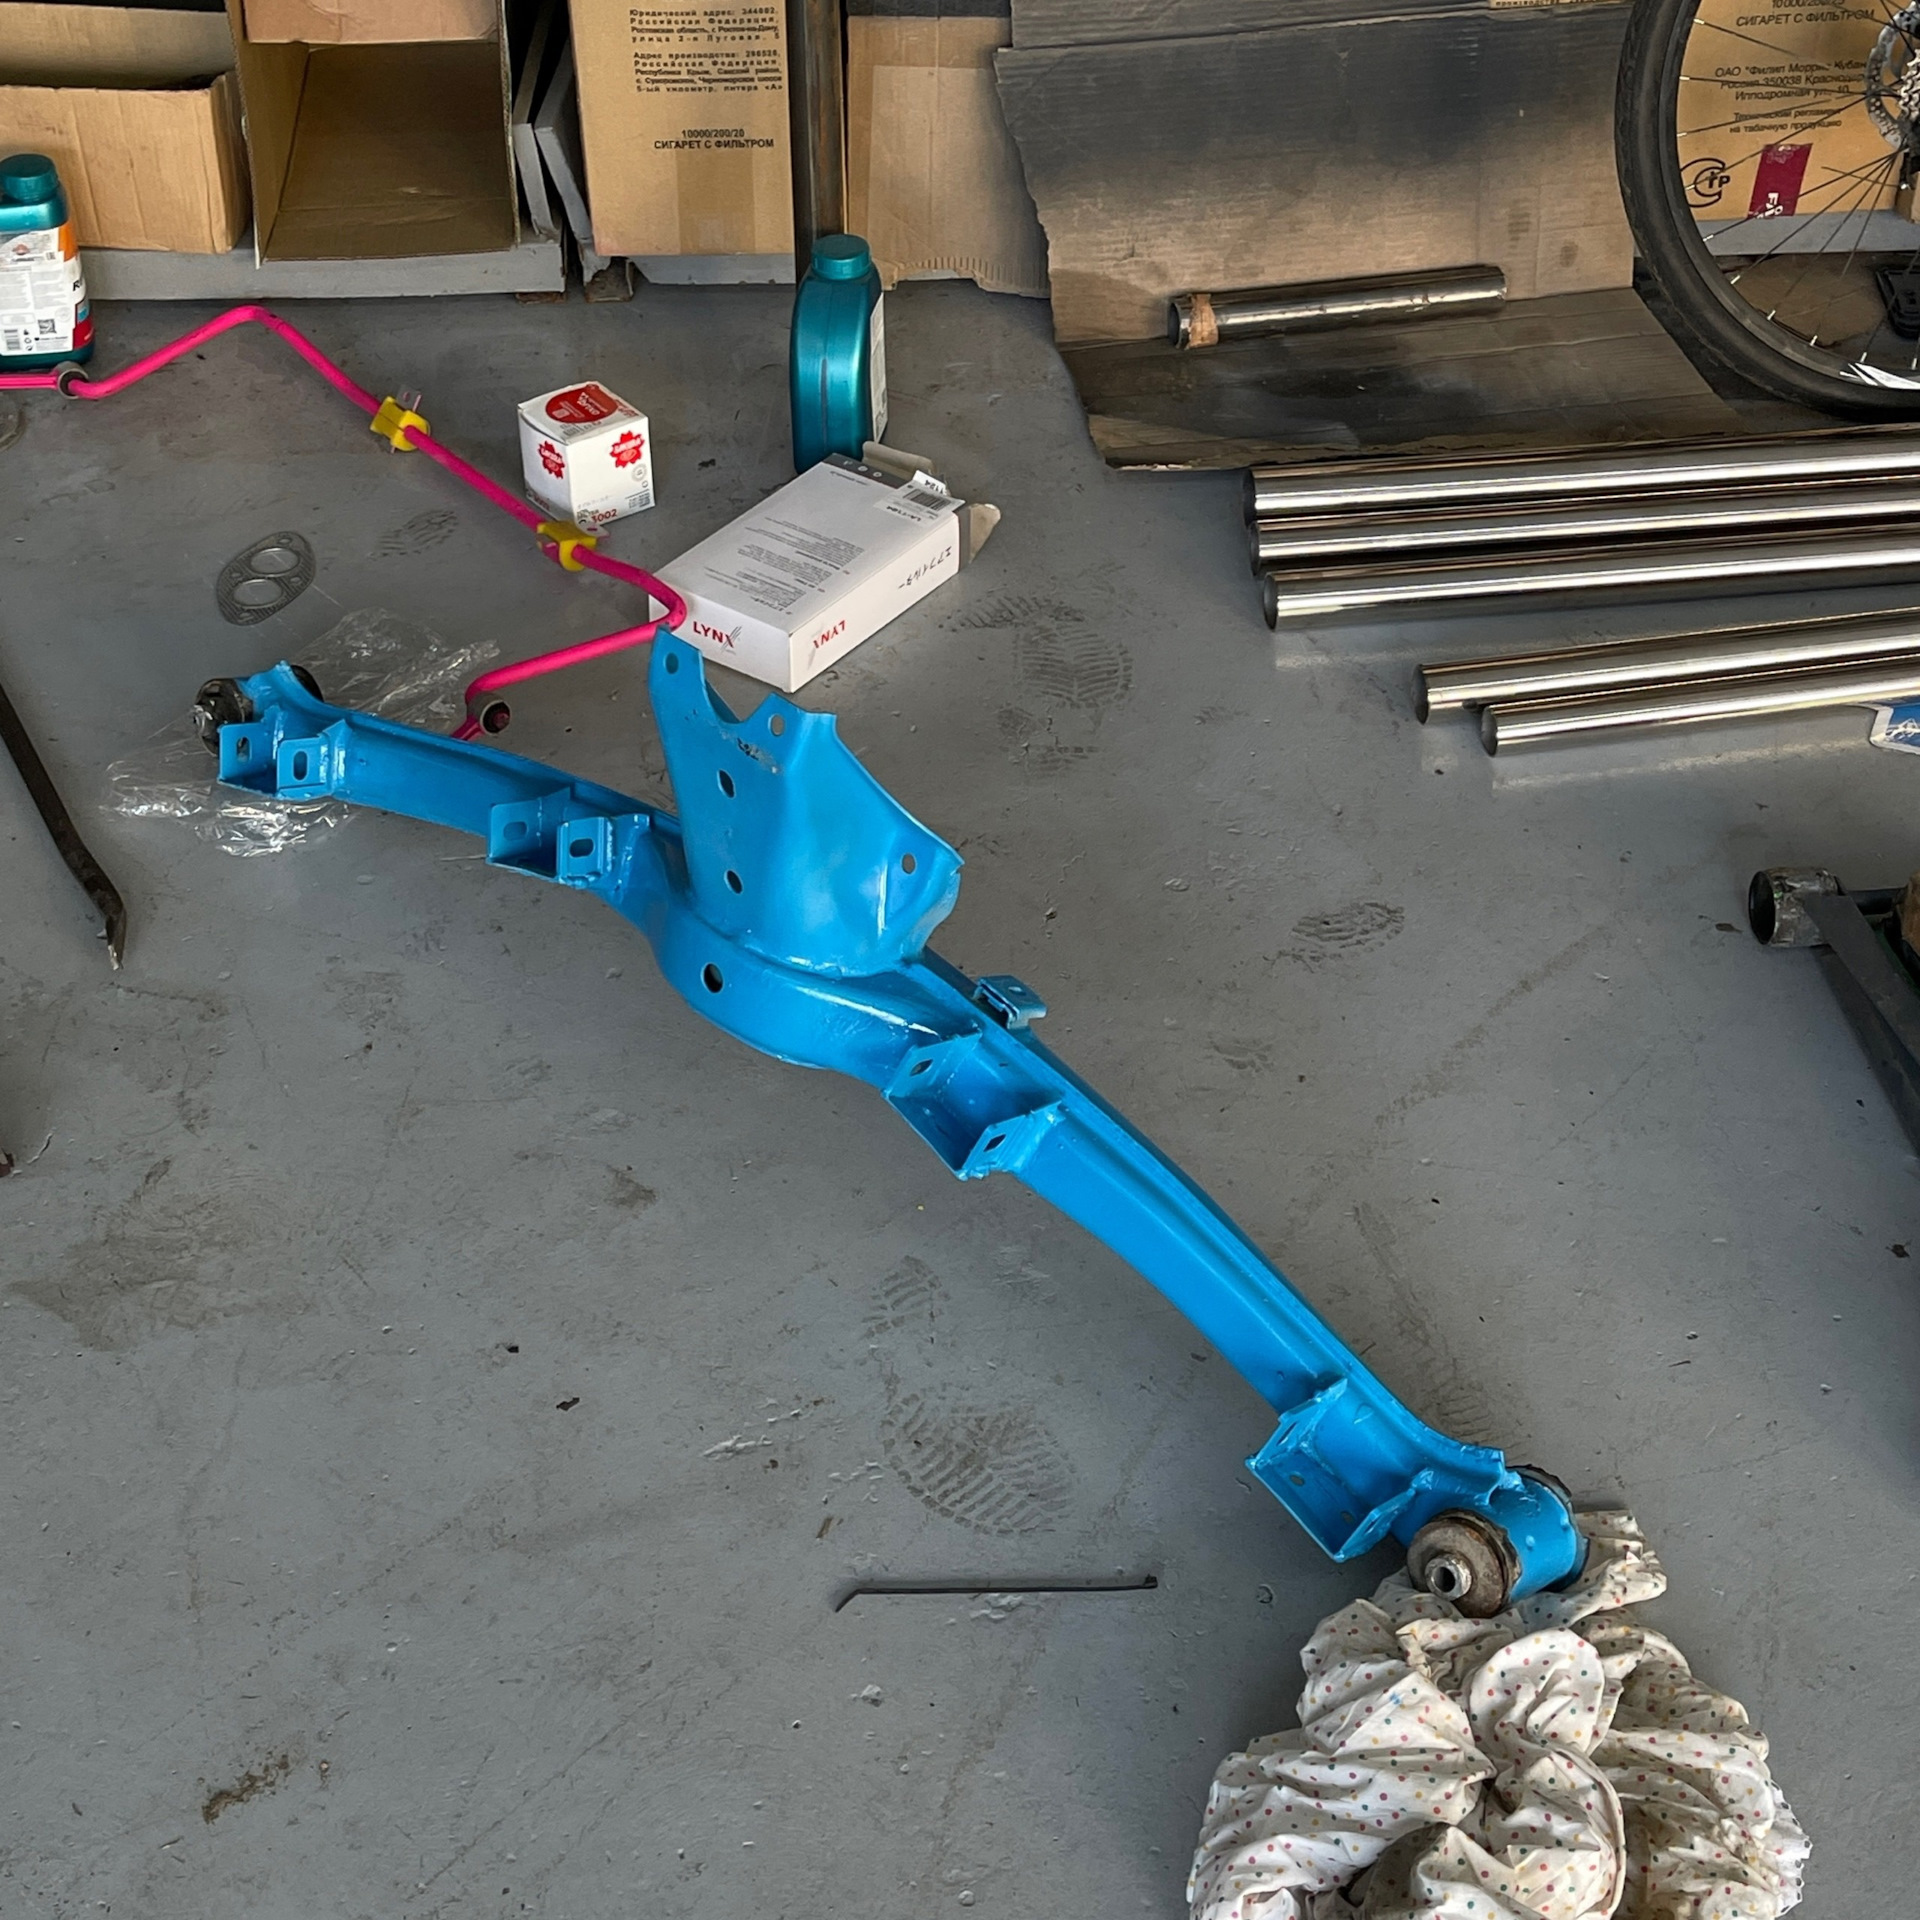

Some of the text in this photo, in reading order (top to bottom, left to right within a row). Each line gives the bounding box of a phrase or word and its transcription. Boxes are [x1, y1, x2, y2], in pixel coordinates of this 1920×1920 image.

[1736, 9, 1875, 26] СИГАРЕТ С ФИЛЬТРОМ
[634, 52, 662, 60] Адрес
[1715, 66, 1741, 77] ОАО
[681, 128, 745, 138] 10000/200/20
[654, 139, 774, 149] СИГАРЕТ С ФИЛЬТРОМ
[693, 621, 735, 648] LYNX
